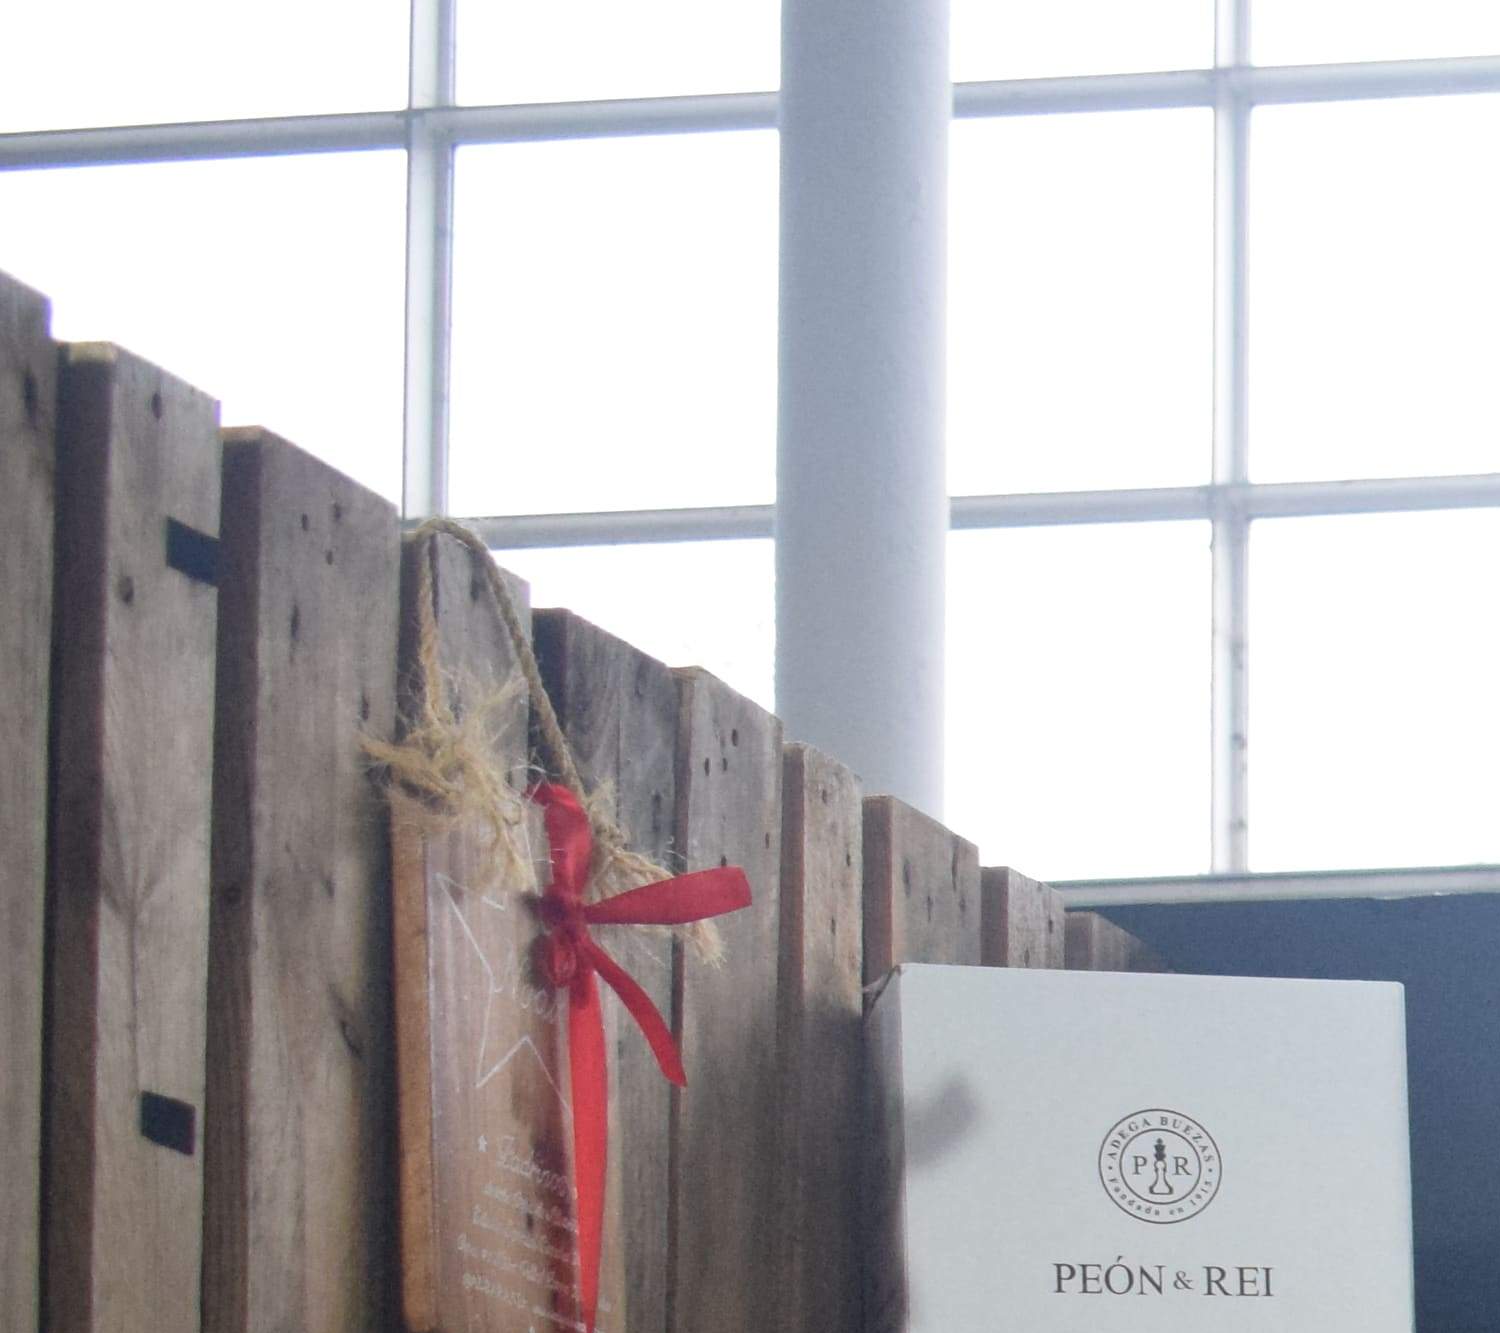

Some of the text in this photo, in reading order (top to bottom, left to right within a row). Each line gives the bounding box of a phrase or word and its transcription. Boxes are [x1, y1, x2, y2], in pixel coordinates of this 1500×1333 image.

[1108, 1116, 1214, 1162] ADEGA BUEZAS
[1132, 1155, 1192, 1176] P R
[1053, 1255, 1273, 1297] PEÓN & REI
